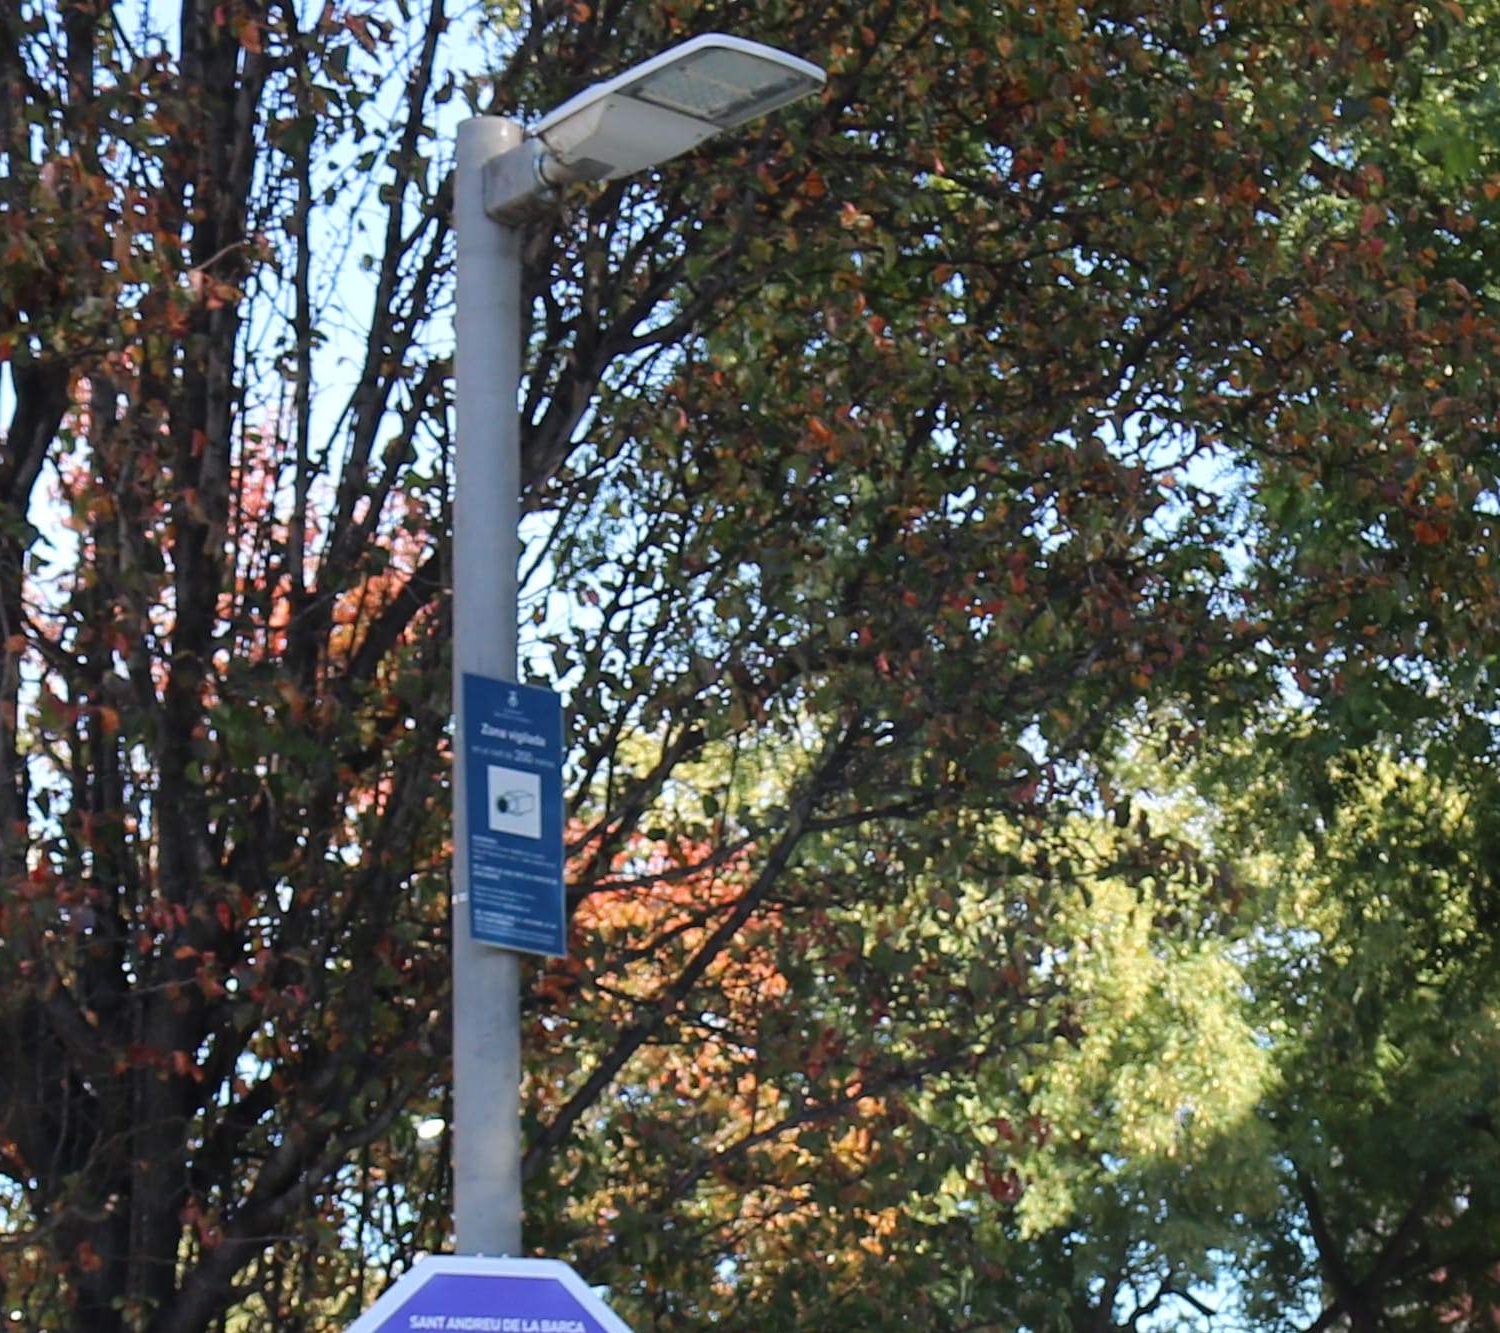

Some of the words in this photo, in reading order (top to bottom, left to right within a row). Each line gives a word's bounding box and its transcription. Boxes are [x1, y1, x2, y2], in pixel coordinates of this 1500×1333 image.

[410, 1315, 446, 1330] SANT
[447, 1317, 500, 1332] ANDREU
[503, 1318, 520, 1332] DE
[522, 1319, 539, 1333] LA
[541, 1319, 586, 1333] BARCA
